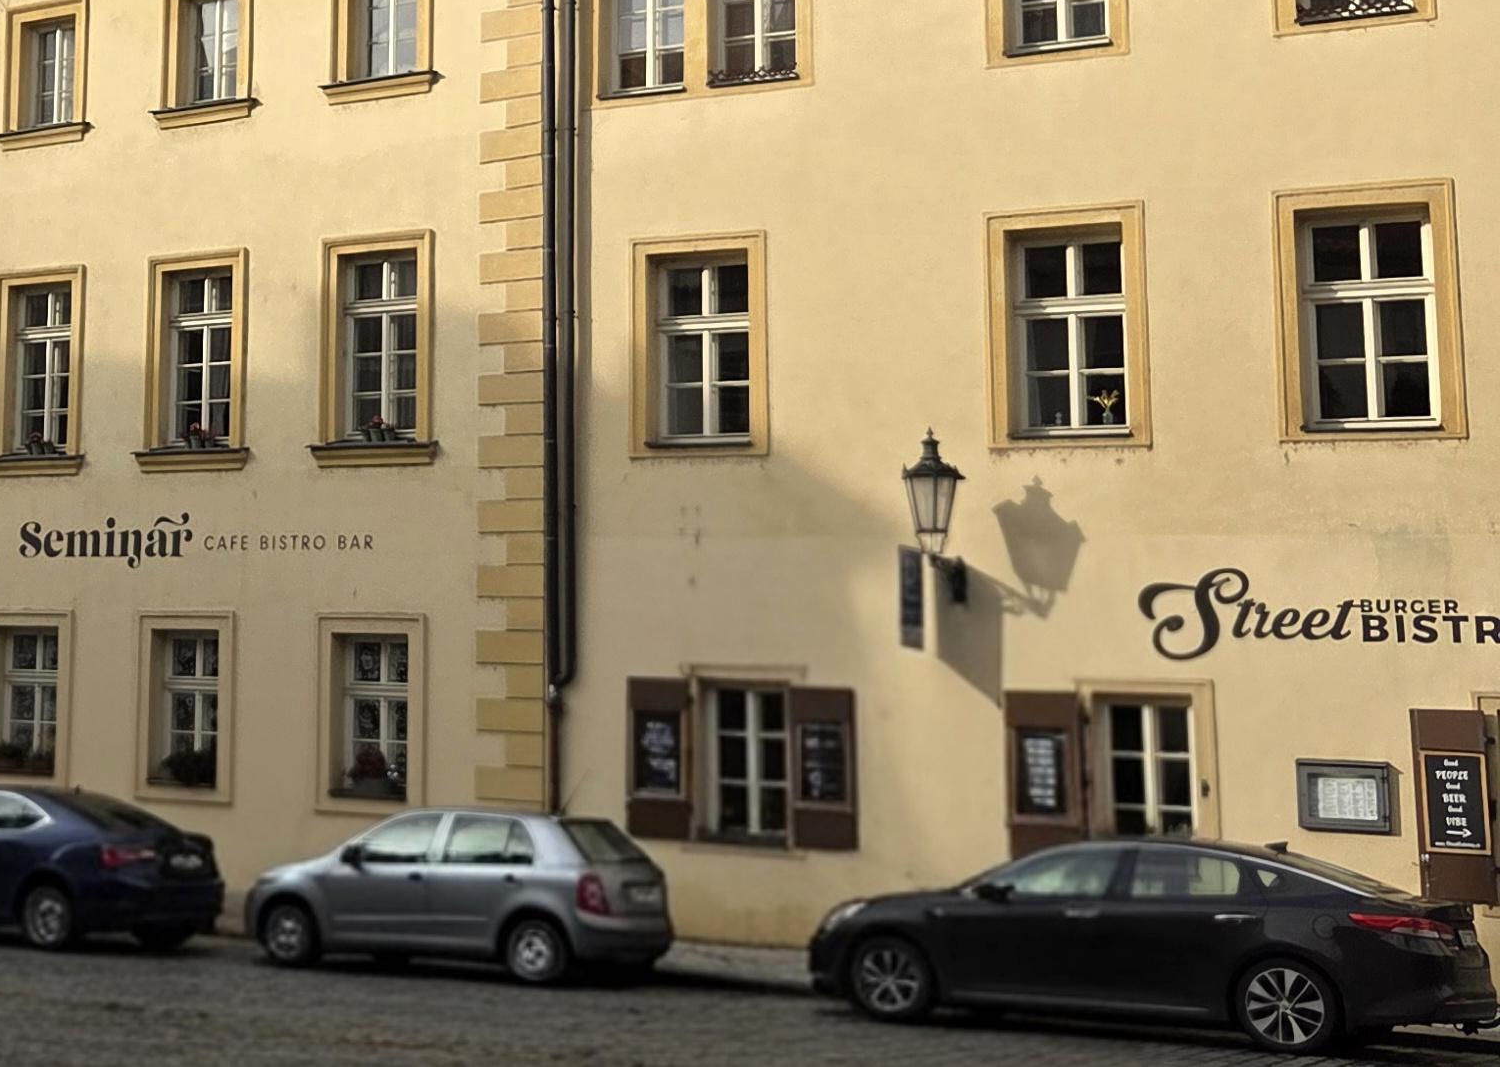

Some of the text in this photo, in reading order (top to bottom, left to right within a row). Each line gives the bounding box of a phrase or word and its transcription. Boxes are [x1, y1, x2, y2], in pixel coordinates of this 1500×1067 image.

[204, 534, 249, 551] CAFE
[259, 534, 326, 551] BISTRO
[337, 534, 375, 551] BAR
[1360, 598, 1460, 614] BURGER
[1137, 567, 1358, 662] Street
[1435, 770, 1469, 781] PEOPLE
[1442, 793, 1467, 804] BEER
[1445, 816, 1468, 827] VIBE
